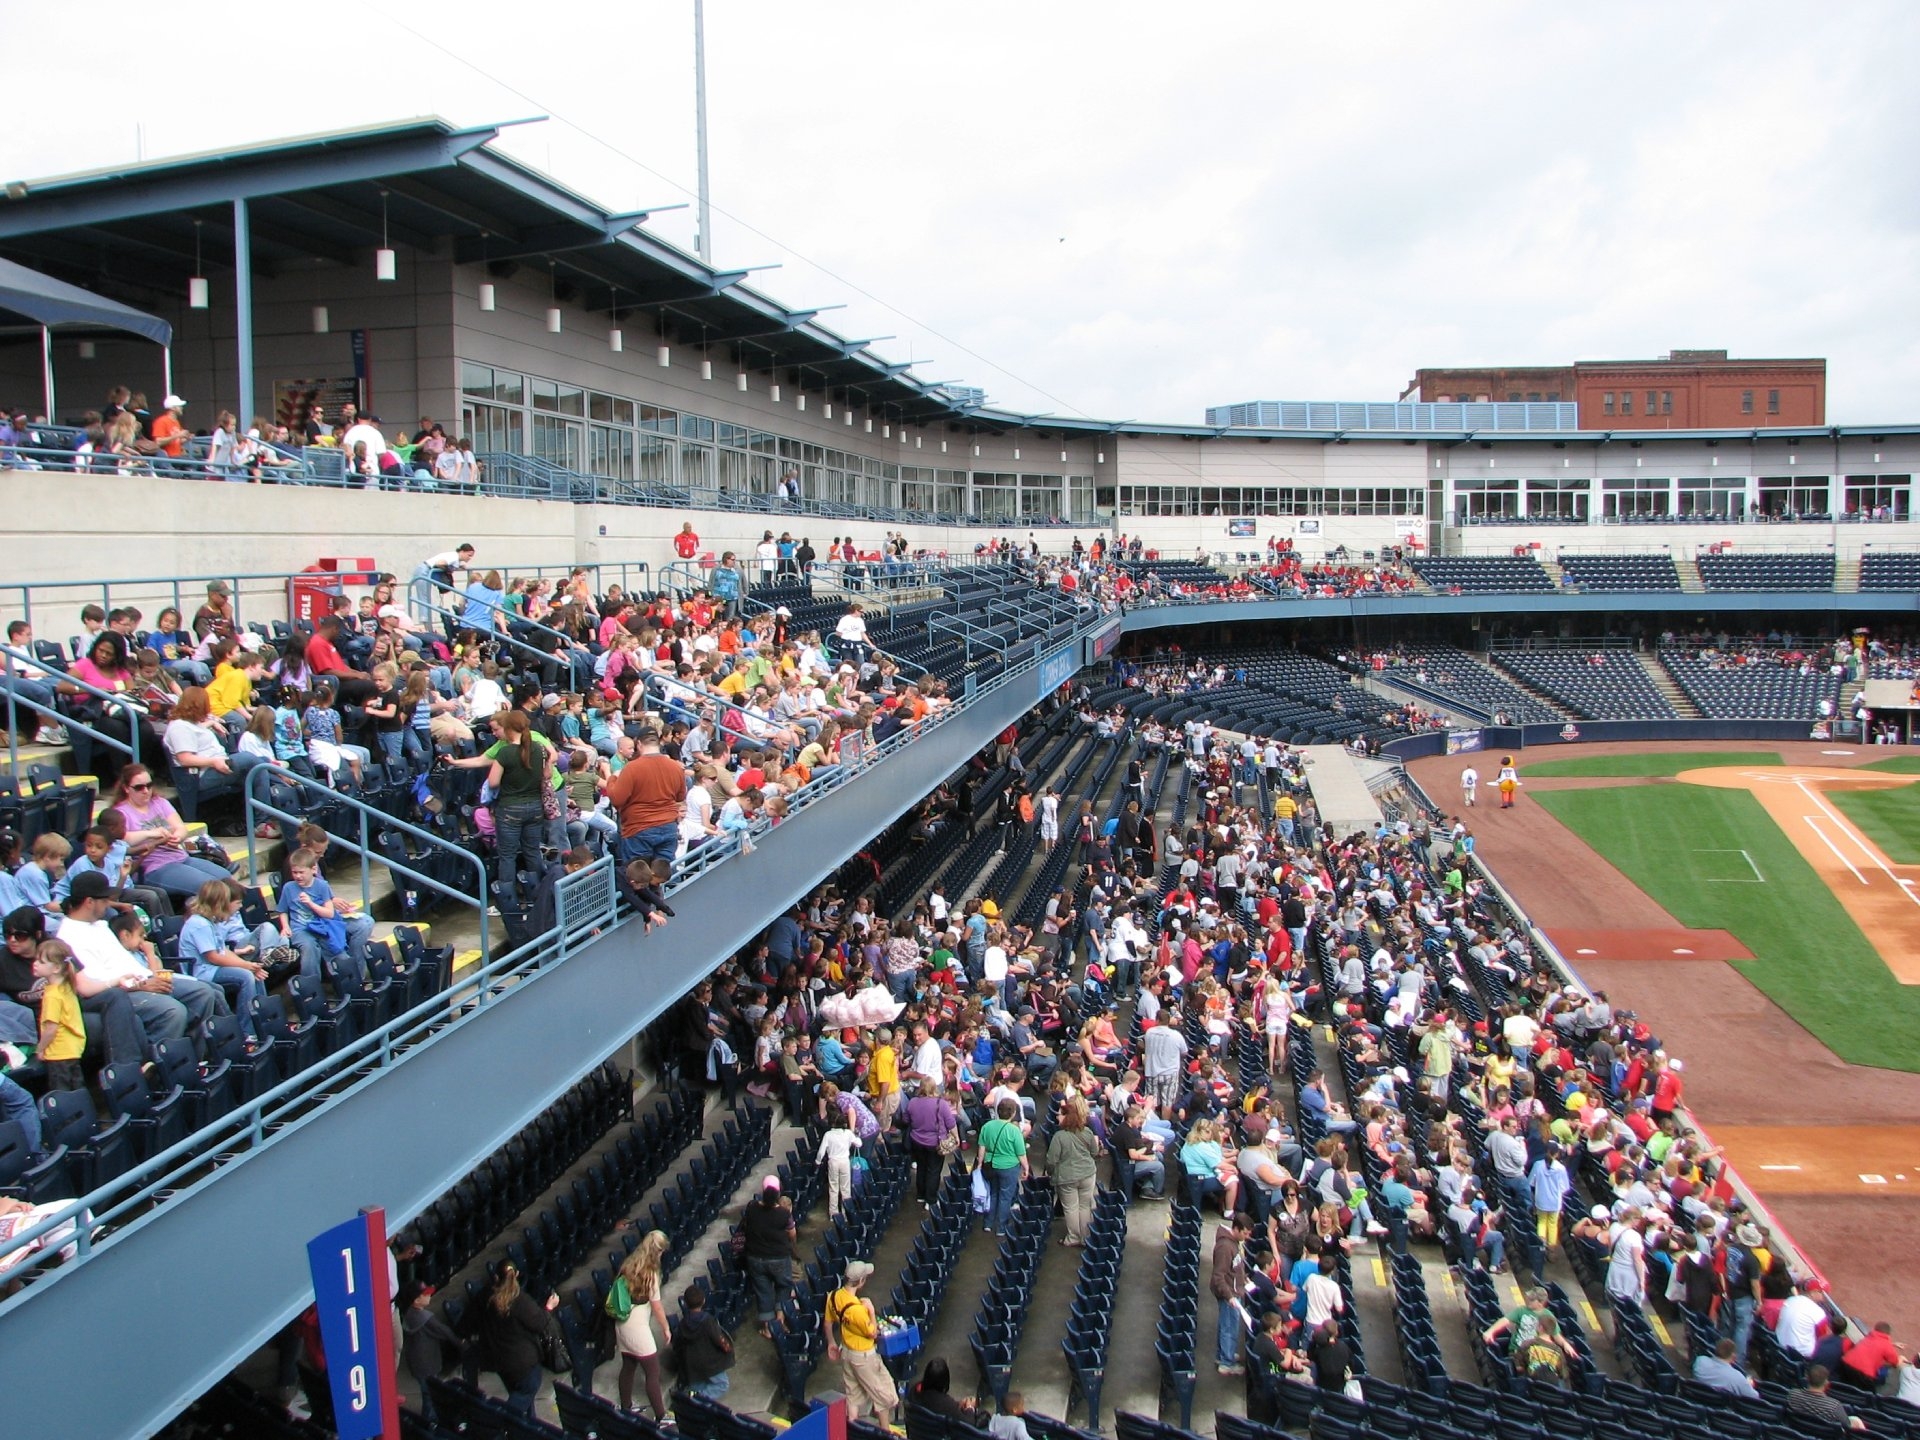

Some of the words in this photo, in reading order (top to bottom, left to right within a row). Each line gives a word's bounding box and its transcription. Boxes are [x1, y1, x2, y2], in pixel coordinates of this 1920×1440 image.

[301, 594, 312, 620] YCLE
[1104, 875, 1114, 888] 11
[341, 1247, 368, 1411] 119
